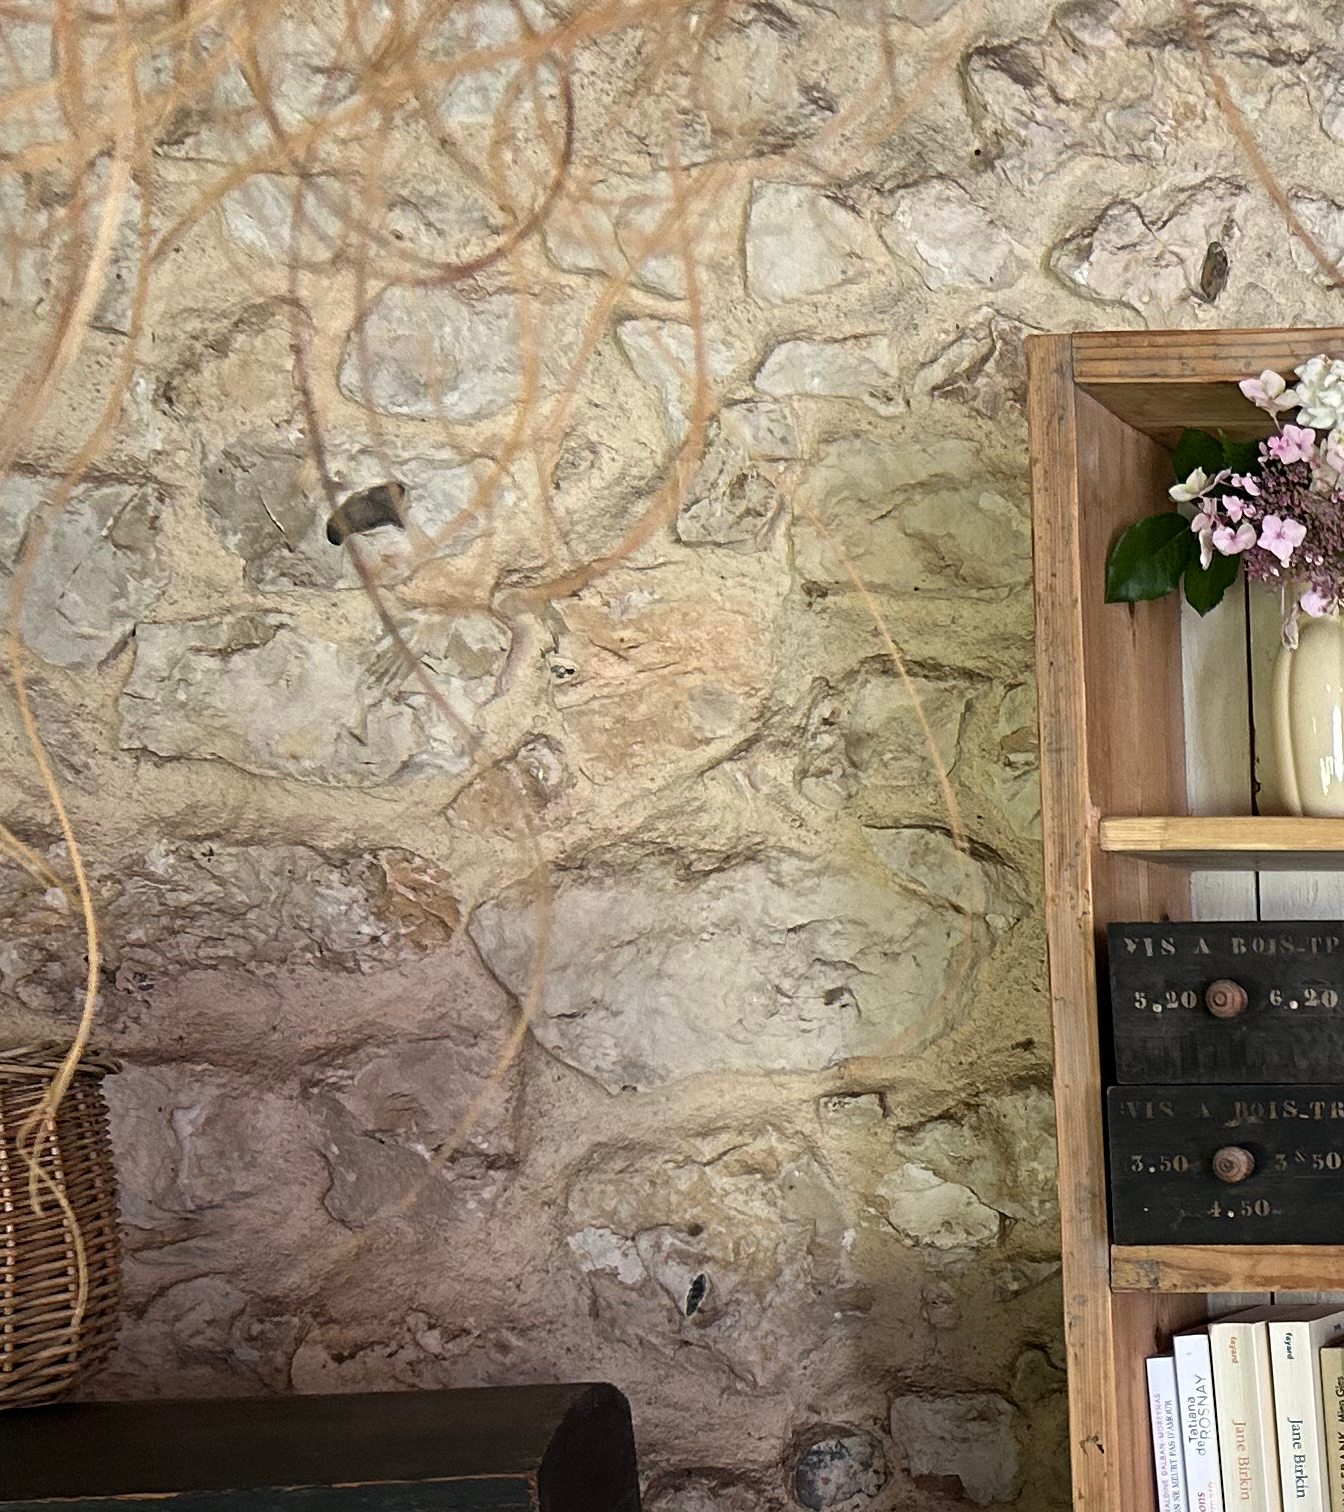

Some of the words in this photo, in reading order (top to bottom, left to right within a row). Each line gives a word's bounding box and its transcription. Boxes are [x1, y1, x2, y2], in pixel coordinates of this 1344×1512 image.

[1124, 937, 1175, 956] VIS
[1228, 1336, 1239, 1364] fayard
[1283, 1332, 1294, 1360] fayard
[1335, 1375, 1344, 1396] Gies
[1184, 1395, 1199, 1442] Tatiana
[1194, 1373, 1212, 1439] ROSNAY
[1231, 1418, 1249, 1452] Jane
[1286, 1416, 1305, 1449] Jane
[1167, 1440, 1177, 1456] PAS
[1196, 1440, 1206, 1456] de
[1237, 1455, 1253, 1500] Birkin
[1292, 1453, 1309, 1499] Birkin
[1171, 1489, 1180, 1502] NE
